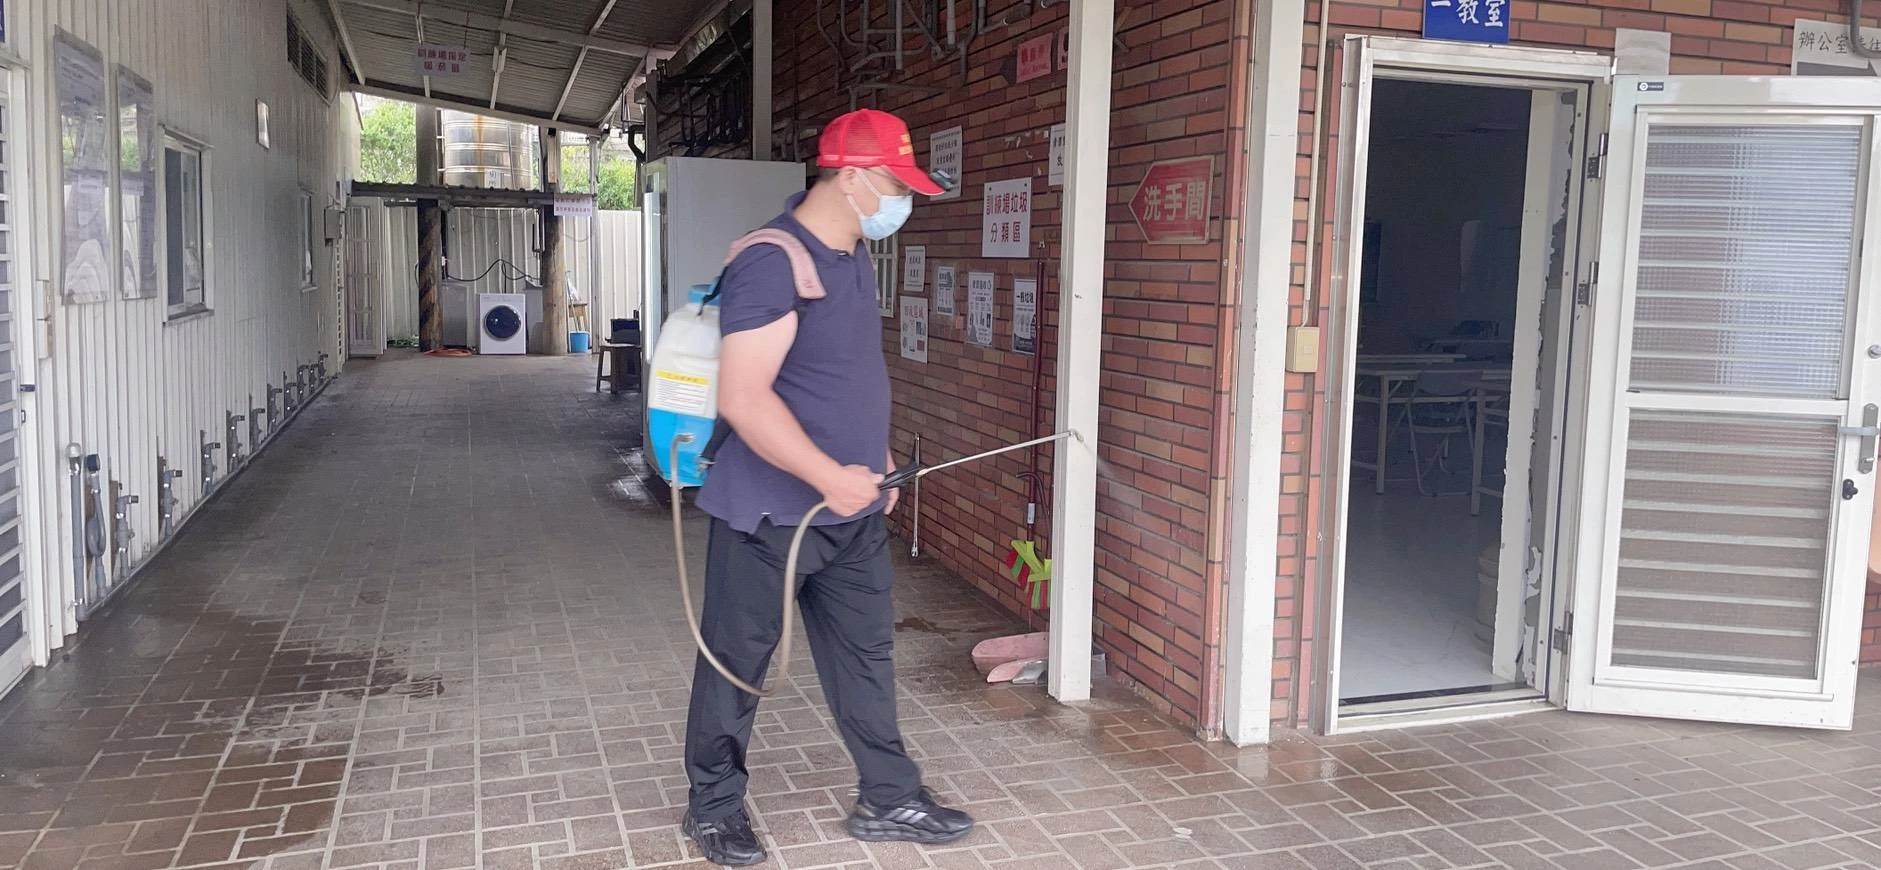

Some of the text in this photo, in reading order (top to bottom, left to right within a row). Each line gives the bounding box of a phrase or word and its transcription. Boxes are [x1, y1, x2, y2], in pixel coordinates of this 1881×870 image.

[1799, 31, 1881, 54] 辦公室往
[986, 192, 1028, 215] 訓練場垃圾
[1143, 178, 1206, 221] 洗手間
[990, 222, 1021, 243] 分類區
